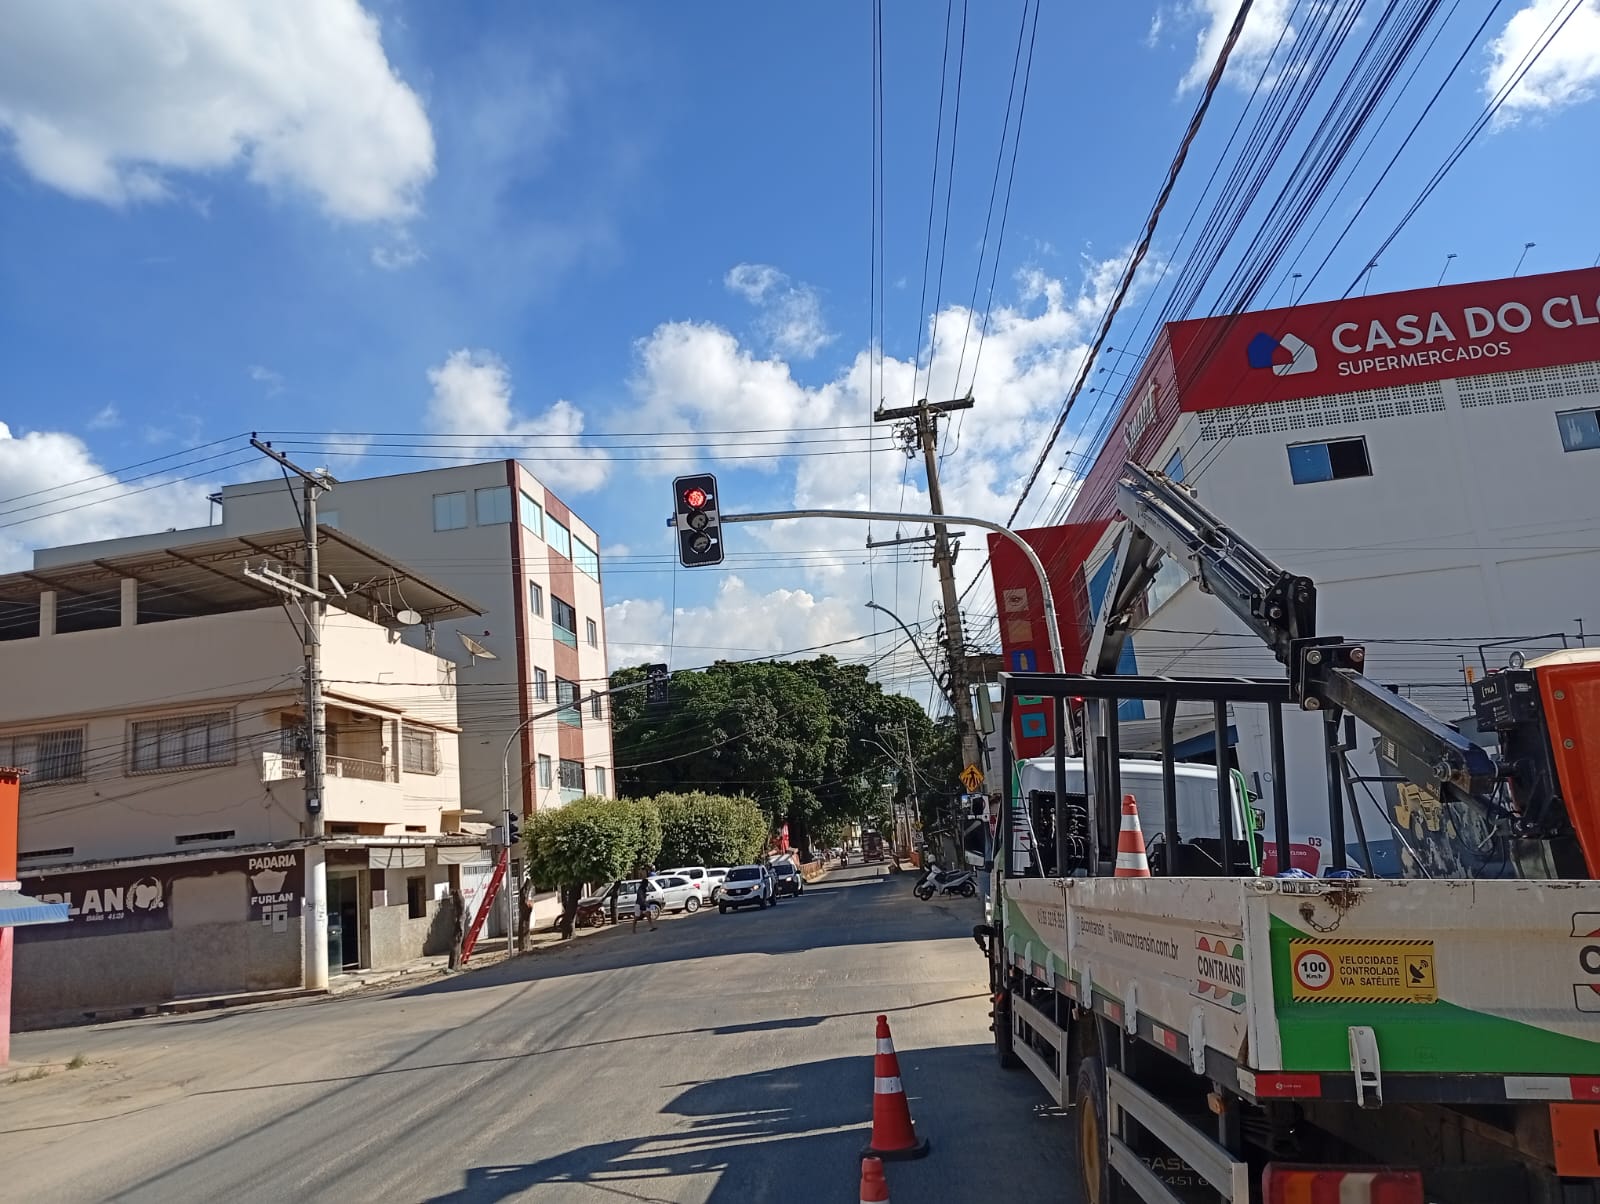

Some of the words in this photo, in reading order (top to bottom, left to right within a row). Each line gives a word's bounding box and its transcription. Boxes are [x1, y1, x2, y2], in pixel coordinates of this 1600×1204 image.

[1332, 311, 1456, 354] CASA
[1464, 301, 1532, 339] DO
[1542, 295, 1600, 327] CL
[1337, 341, 1511, 376] SUPERMERCADOS
[1308, 836, 1322, 847] 03
[249, 854, 296, 870] PADARIA
[251, 892, 294, 905] FURLAN
[1112, 930, 1179, 960] www.contransin.com.br
[1339, 956, 1399, 964] VELOCIDADE
[1301, 962, 1326, 973] 100
[1340, 967, 1399, 975] CONTROLADA
[1341, 977, 1355, 985] VIA
